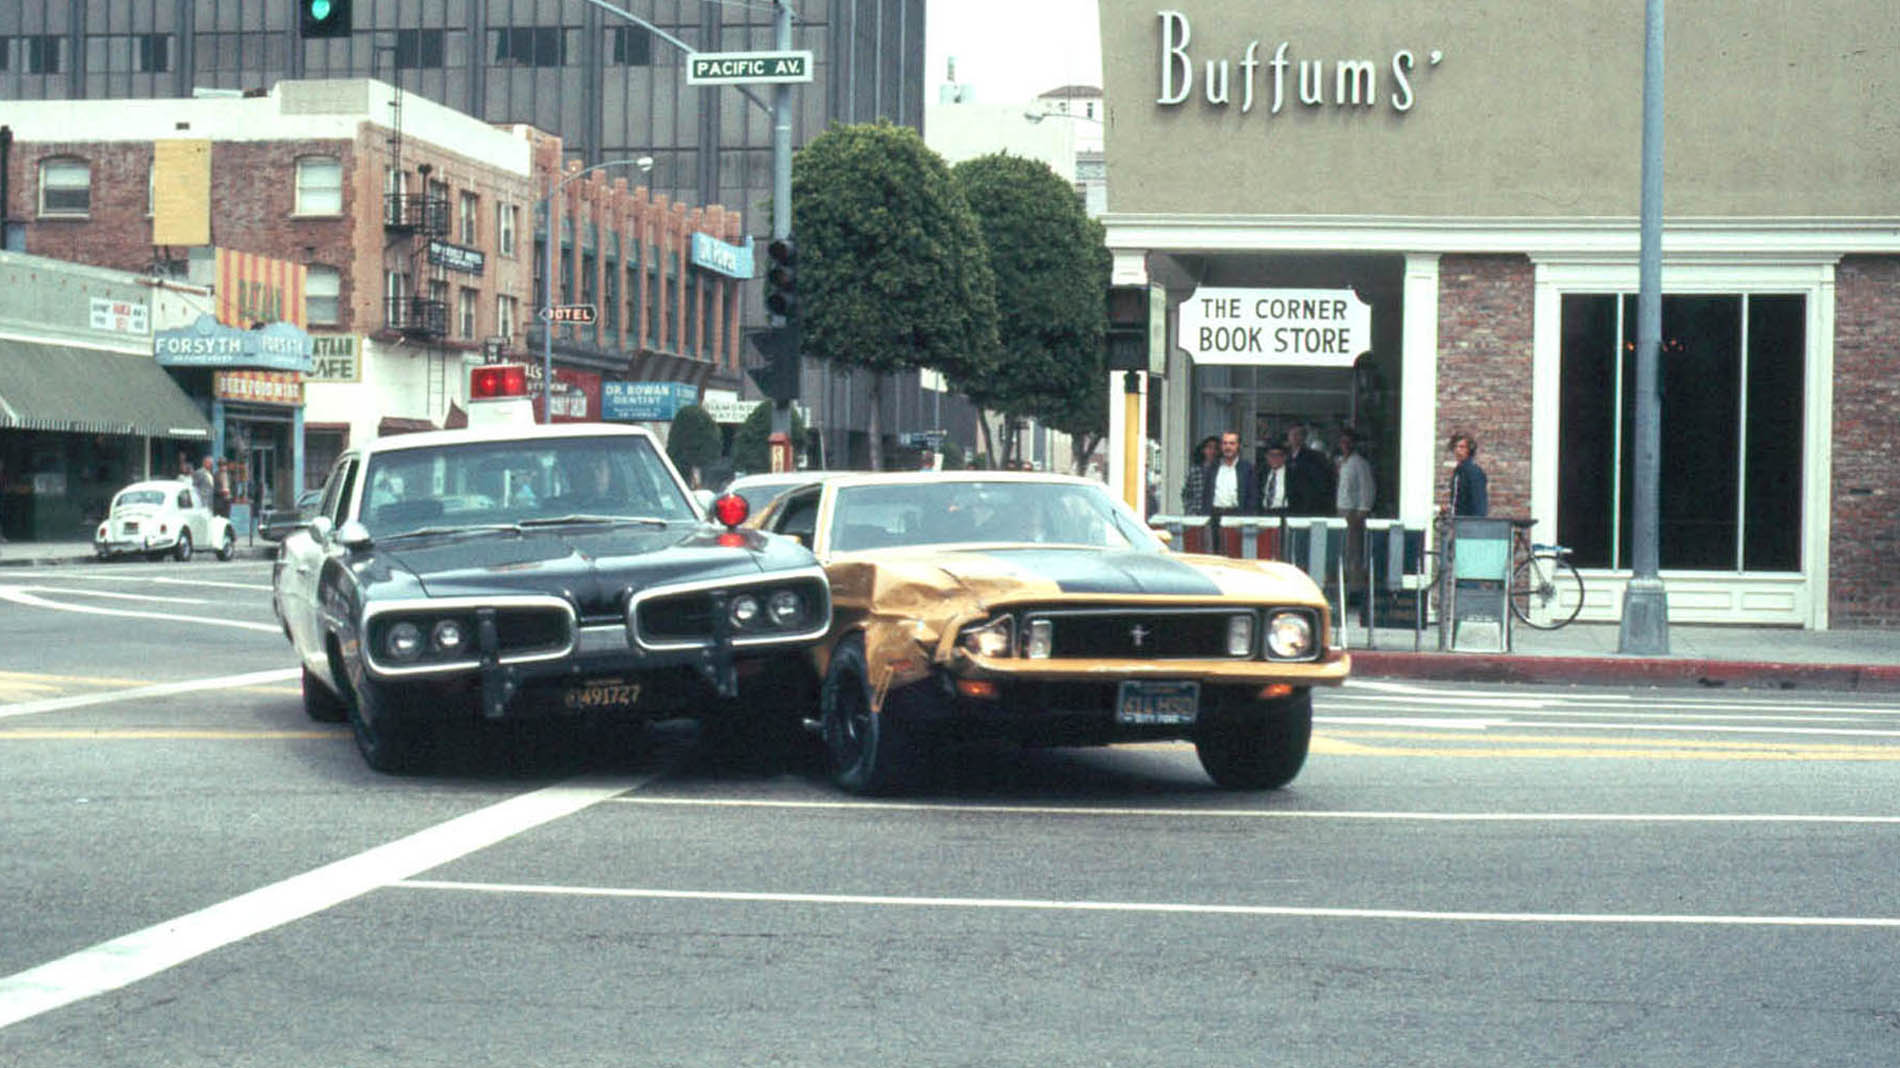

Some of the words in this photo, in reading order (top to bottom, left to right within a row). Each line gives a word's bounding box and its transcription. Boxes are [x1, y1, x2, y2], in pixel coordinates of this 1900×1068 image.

[697, 61, 765, 76] PACIFIC
[775, 60, 800, 74] AV.
[1156, 9, 1443, 114] Buffums'
[1201, 298, 1241, 319] THE
[1255, 299, 1348, 320] CORNER
[155, 337, 241, 354] FORSYTH
[311, 337, 353, 356] ATAAN
[1200, 326, 1262, 353] BOOK
[1274, 327, 1351, 353] STORE
